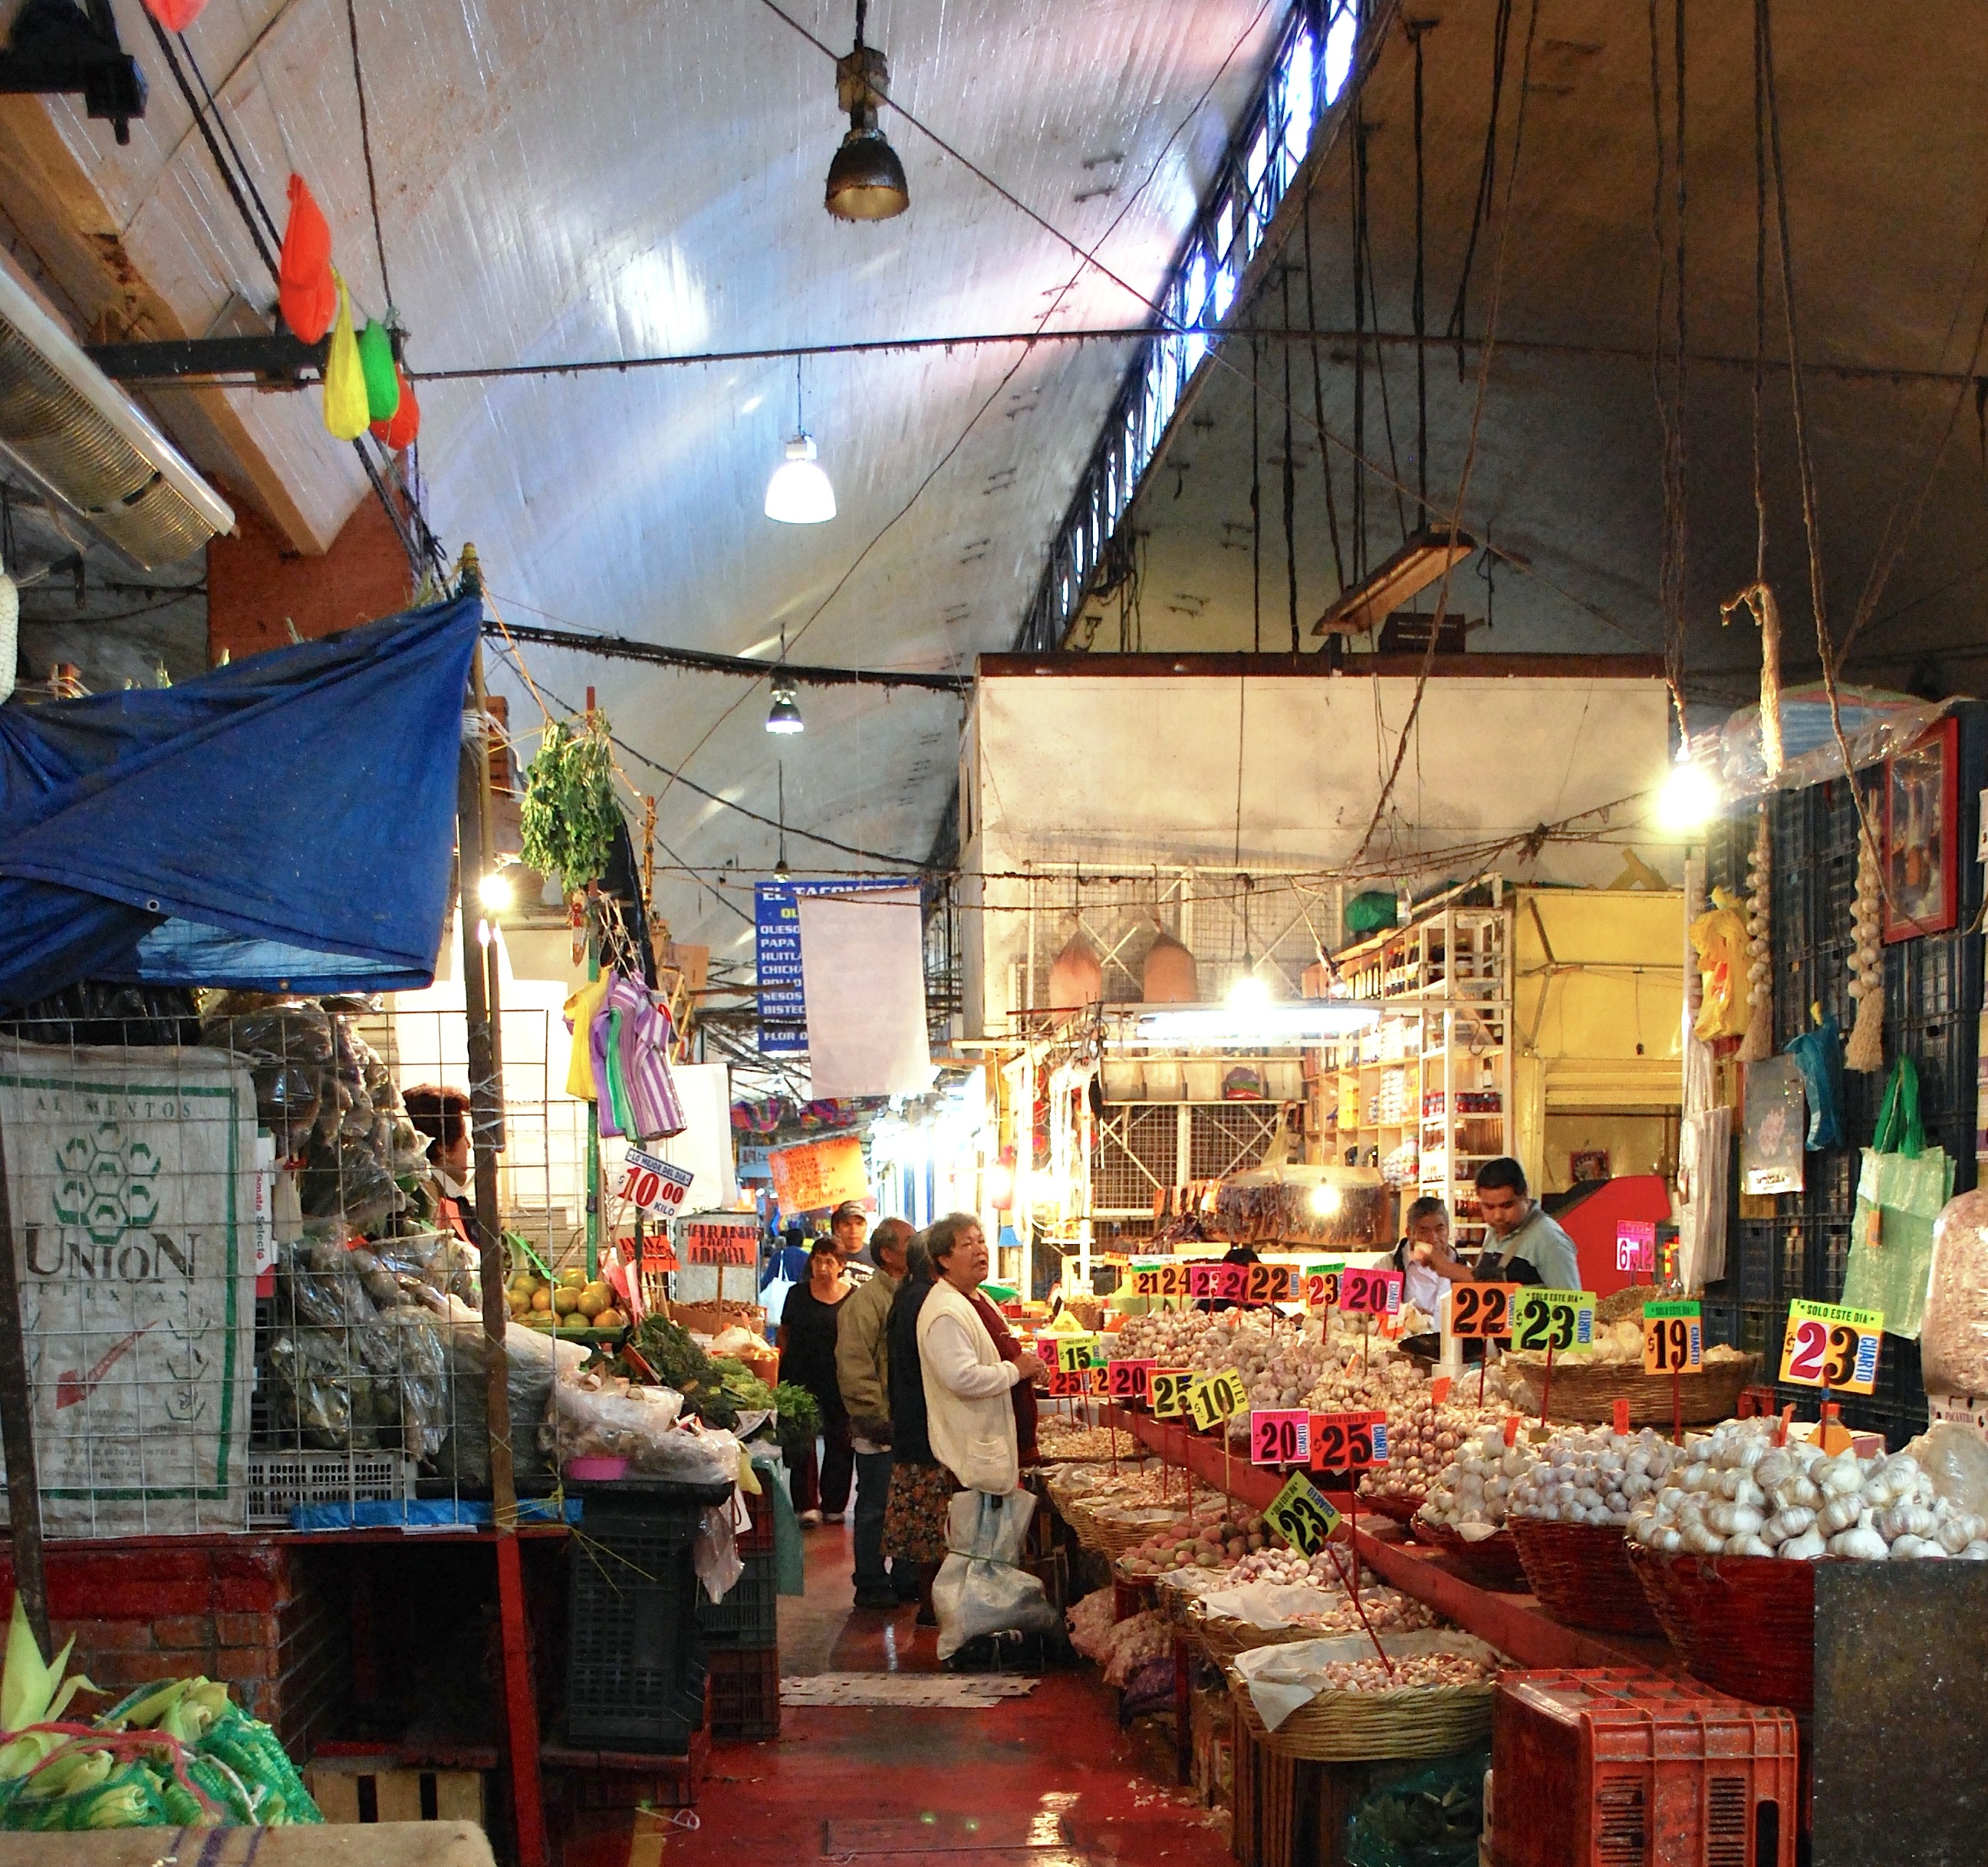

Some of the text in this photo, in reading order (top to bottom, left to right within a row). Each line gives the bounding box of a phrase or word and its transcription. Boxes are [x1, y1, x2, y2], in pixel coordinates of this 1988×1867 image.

[762, 887, 786, 901] EL
[761, 939, 795, 948] PAPA
[764, 1032, 795, 1042] FLOR
[38, 1096, 191, 1118] ALMENTOS
[653, 1201, 675, 1217] KILO
[24, 1223, 201, 1286] UNION
[1163, 1268, 1190, 1295] 24
[1249, 1266, 1289, 1301] 22
[1453, 1287, 1506, 1334] 22
[1550, 1293, 1566, 1302] ESTE
[1578, 1310, 1592, 1344] CUARTO
[1807, 1305, 1868, 1324] SOLO ESTE DIA
[1690, 1326, 1700, 1365] CUARTO
[1855, 1337, 1878, 1382] CUARTO
[1154, 1375, 1193, 1414] 25
[1229, 1375, 1246, 1404] KILO
[1298, 1424, 1307, 1455] CUARTO
[1374, 1426, 1387, 1459] CUARTO
